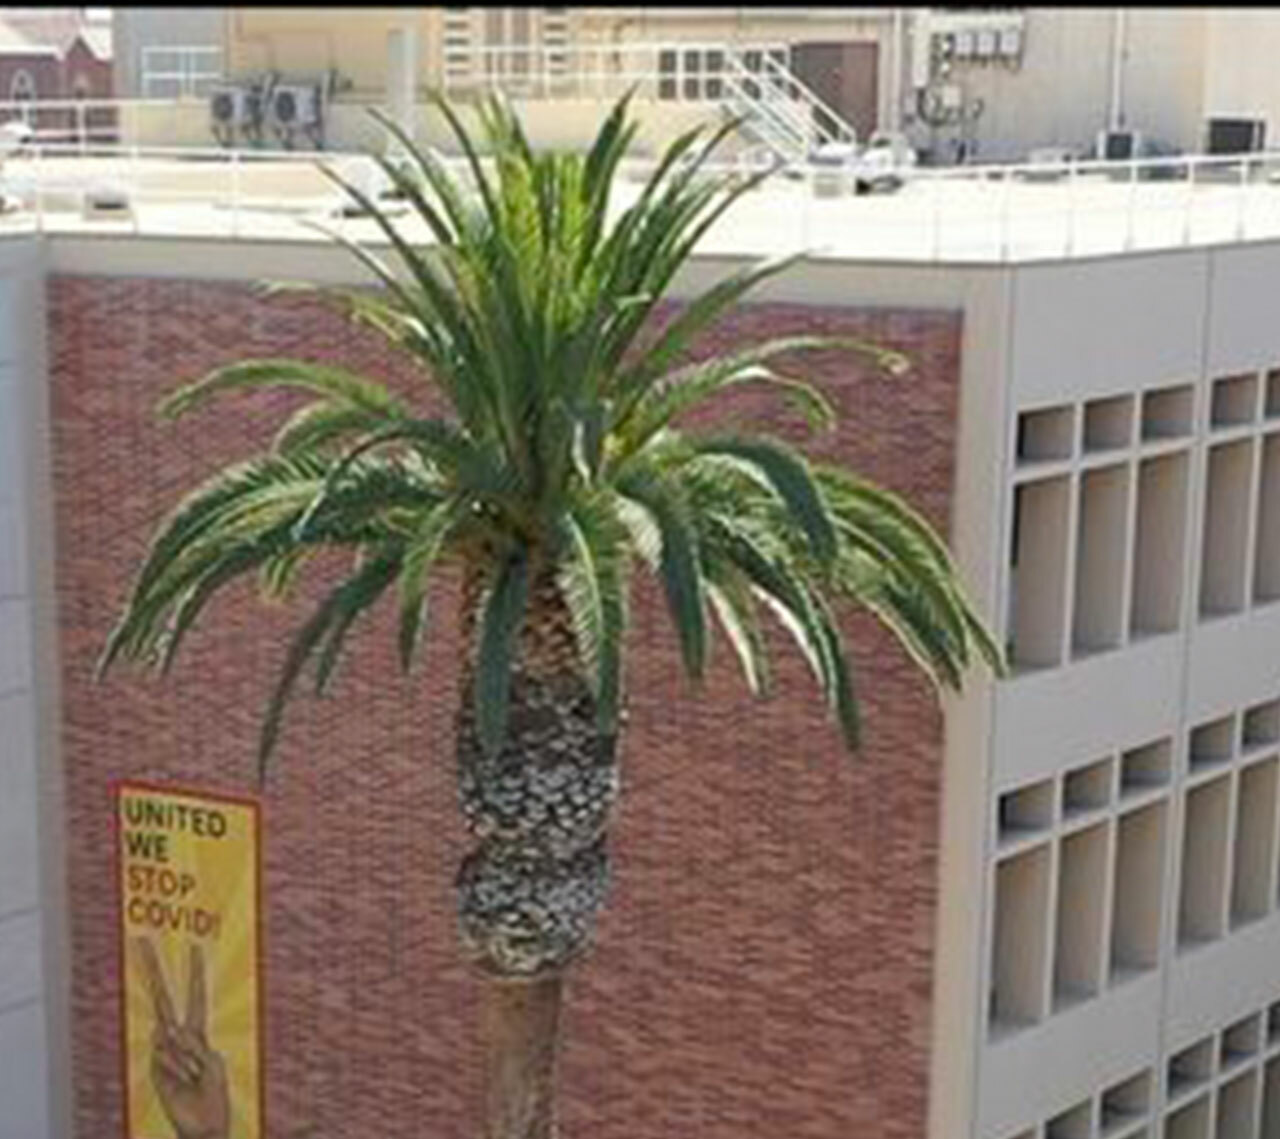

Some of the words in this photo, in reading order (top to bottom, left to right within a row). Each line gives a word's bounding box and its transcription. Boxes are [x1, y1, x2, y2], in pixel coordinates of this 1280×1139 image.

[125, 798, 227, 838] UNITED
[126, 832, 168, 862] WE
[128, 866, 196, 899] STOP
